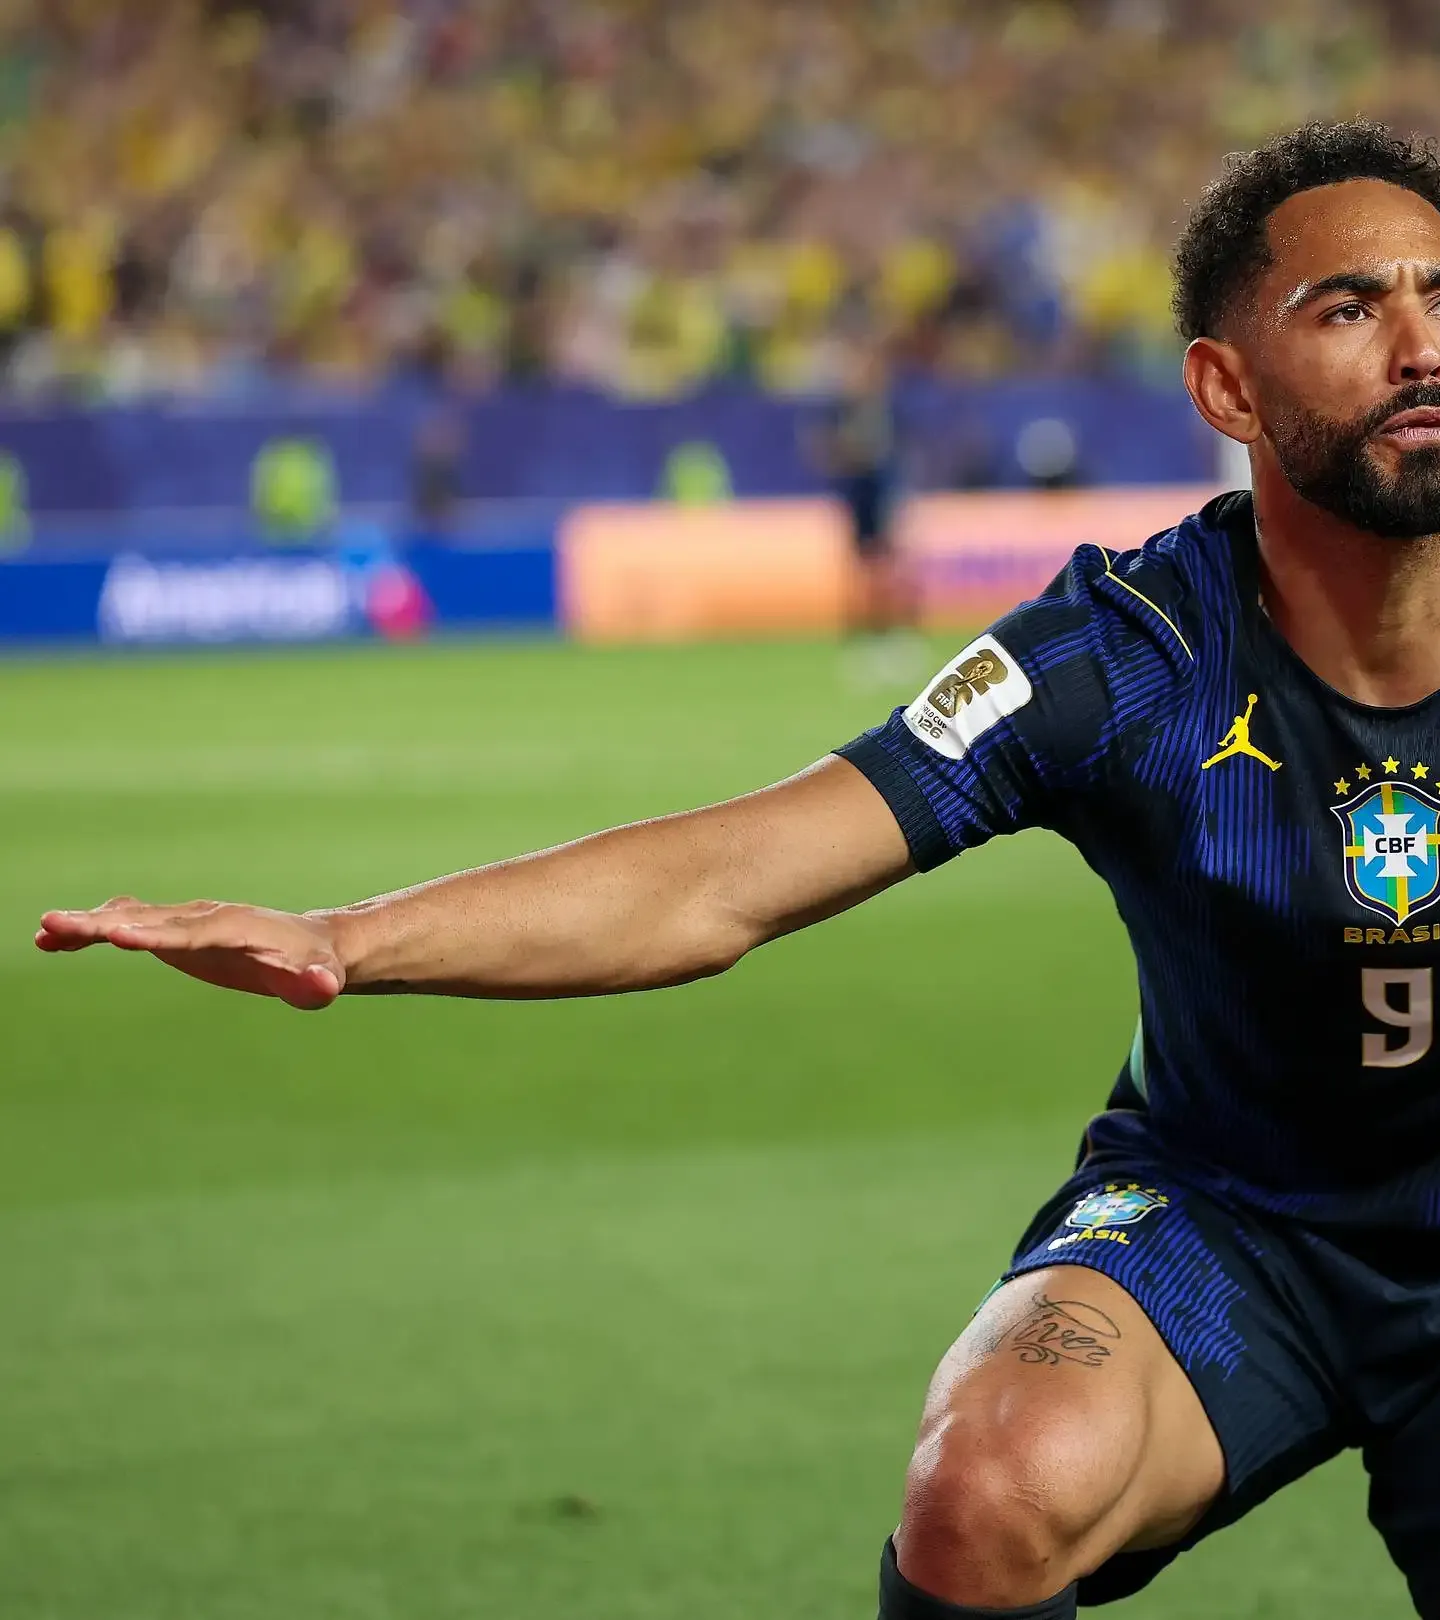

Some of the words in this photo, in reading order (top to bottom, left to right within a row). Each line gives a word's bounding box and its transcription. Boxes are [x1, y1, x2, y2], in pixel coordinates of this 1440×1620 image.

[935, 692, 953, 711] FIFA
[933, 715, 948, 729] CUP
[1375, 836, 1416, 855] CBF
[1361, 967, 1433, 1068] 9
